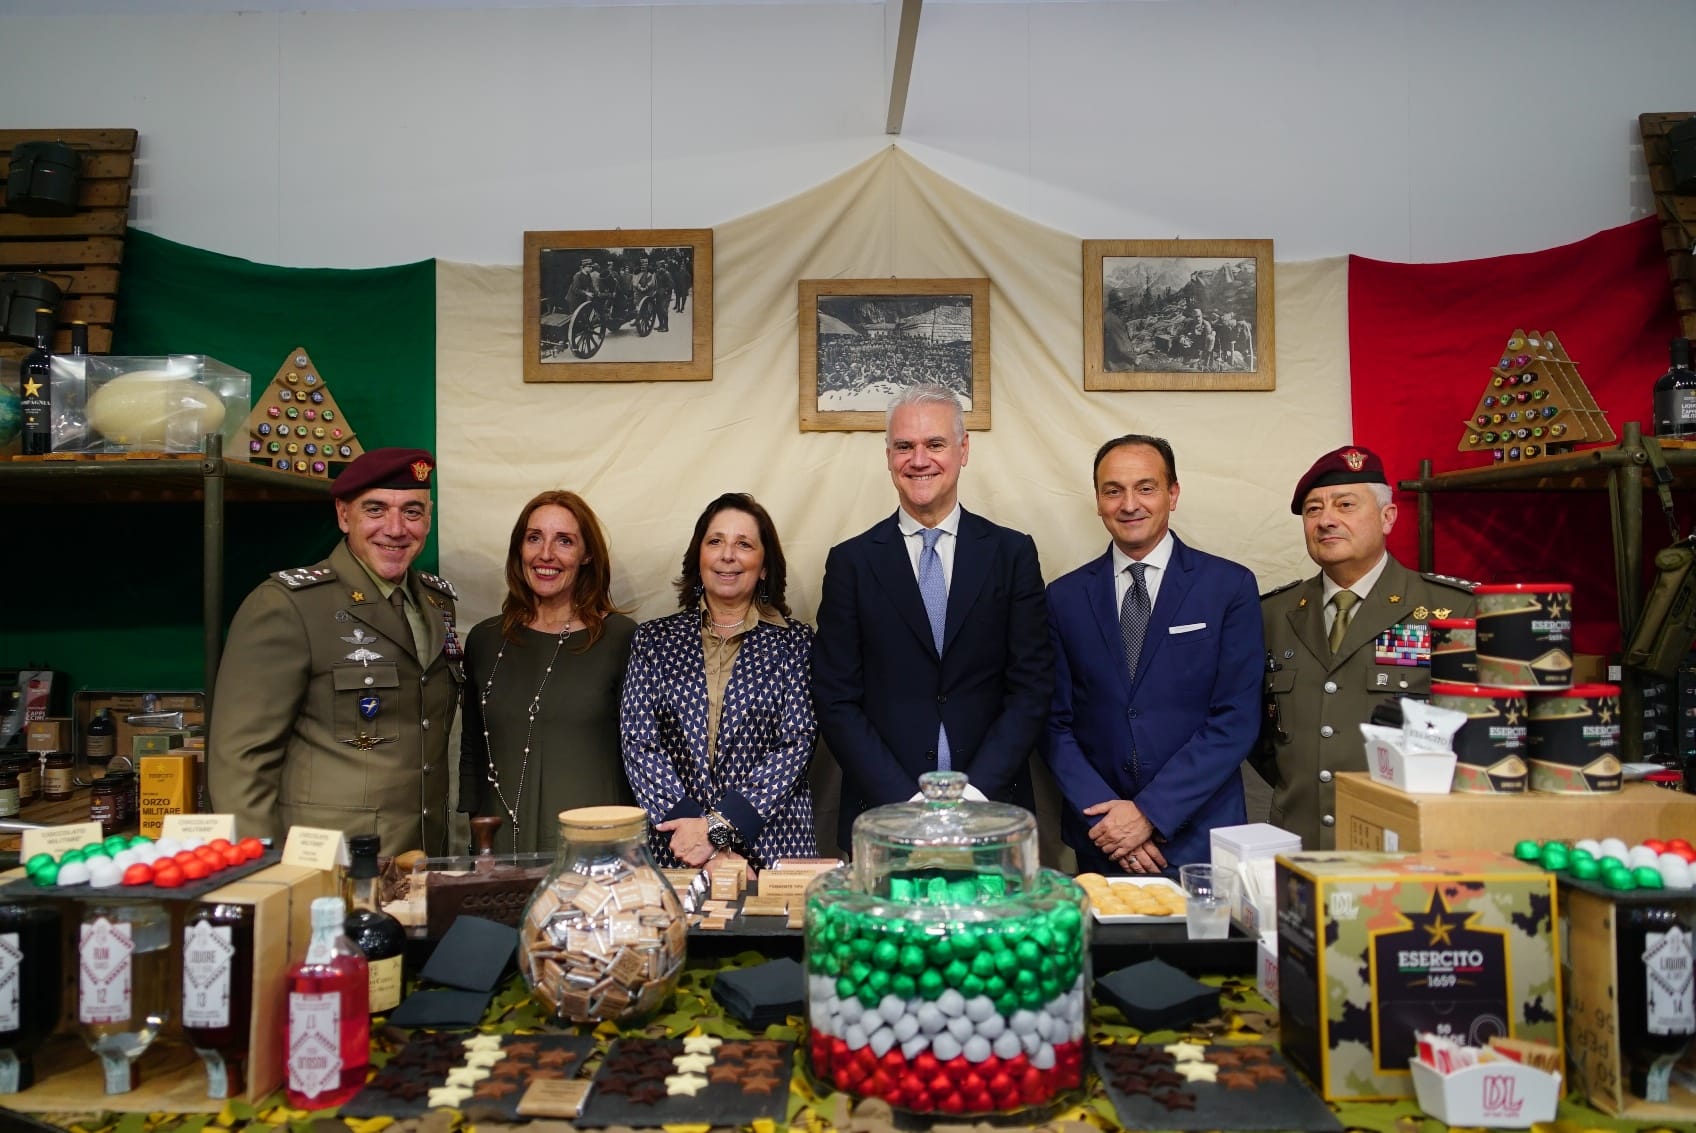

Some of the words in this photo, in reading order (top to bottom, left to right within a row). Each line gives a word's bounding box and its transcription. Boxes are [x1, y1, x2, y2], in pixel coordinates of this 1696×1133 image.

[142, 798, 170, 806] ORZO
[142, 808, 181, 816] MILITARE
[142, 821, 163, 829] RIPO
[1398, 950, 1483, 968] ESERCITO
[1427, 974, 1457, 988] 1659
